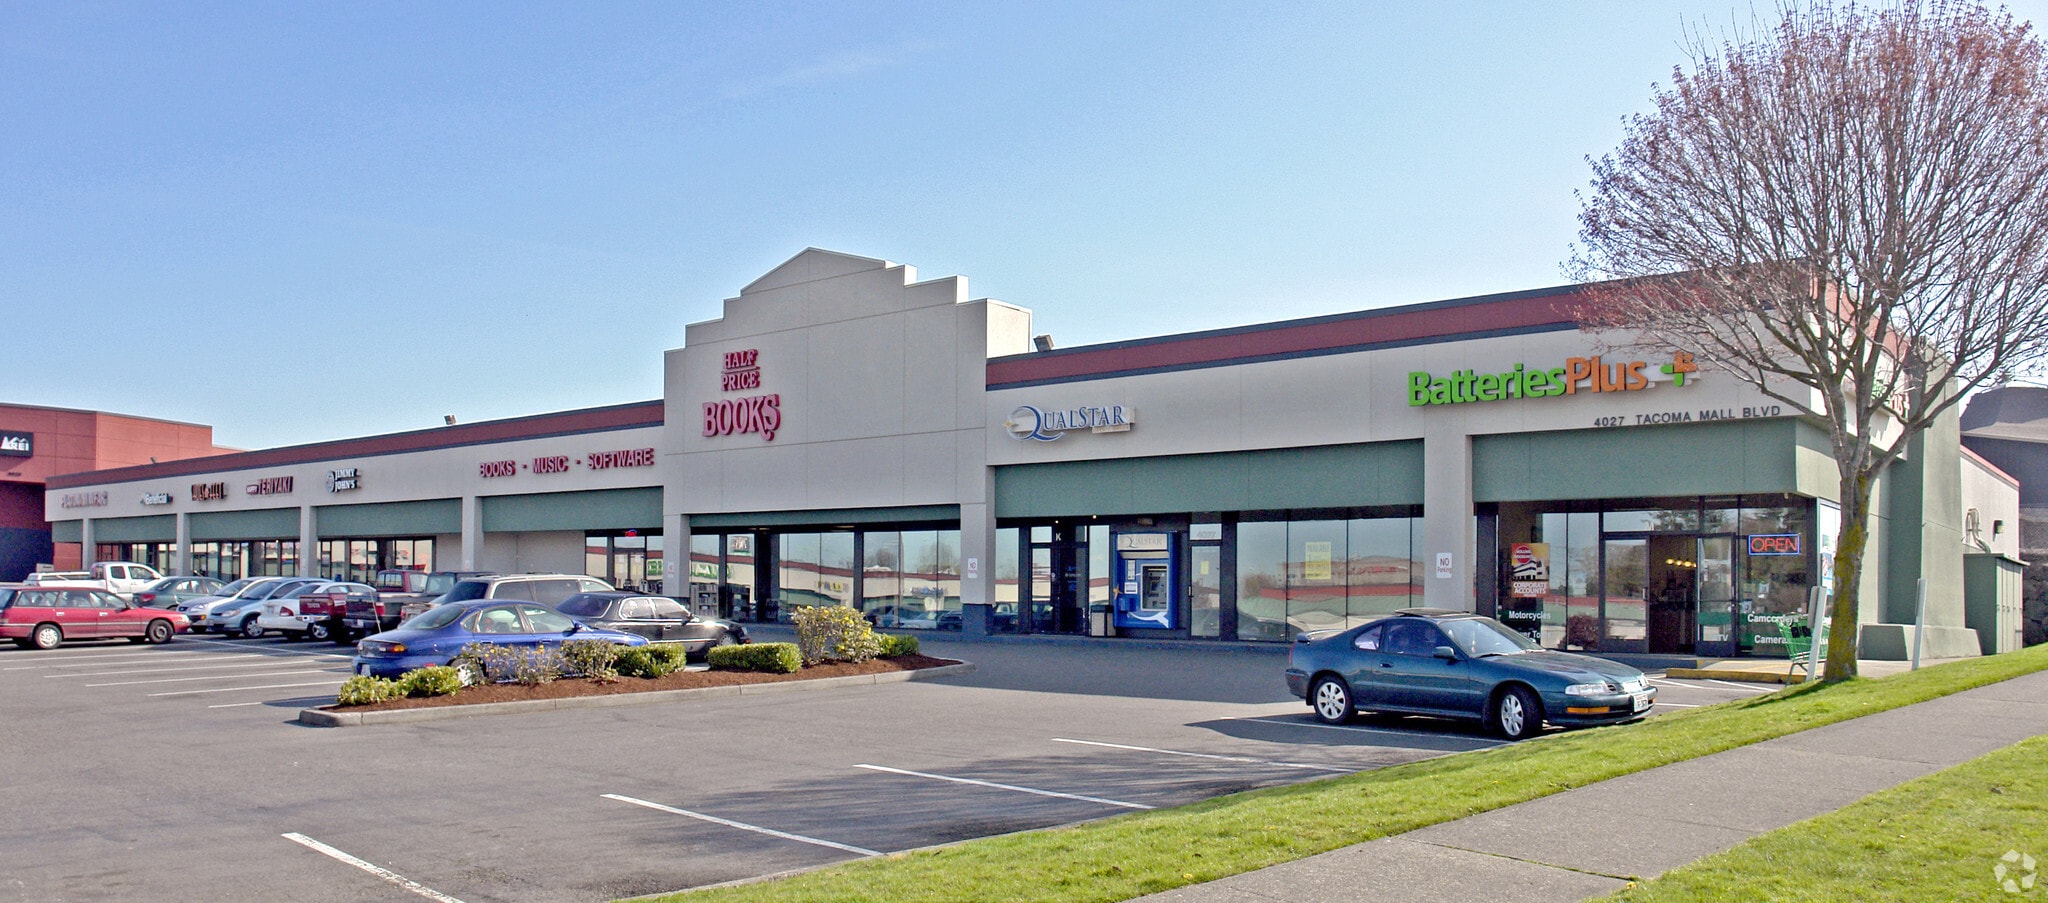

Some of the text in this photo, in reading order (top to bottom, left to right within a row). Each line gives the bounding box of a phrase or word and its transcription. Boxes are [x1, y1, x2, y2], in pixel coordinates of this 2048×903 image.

[723, 349, 758, 368] HALF
[721, 371, 760, 391] PRICE
[702, 394, 781, 441] BOOKS
[1594, 405, 1781, 427] 4027 TACOMA MALL BLVD
[480, 448, 655, 478] BOOKS MUSIC SOFTWARE
[335, 468, 357, 480] JIMMY
[258, 476, 294, 495] TERIYAKI
[1055, 533, 1062, 541] K
[1751, 537, 1798, 552] OPEN
[1440, 557, 1450, 566] NO
[1508, 611, 1551, 621] Motorcycles
